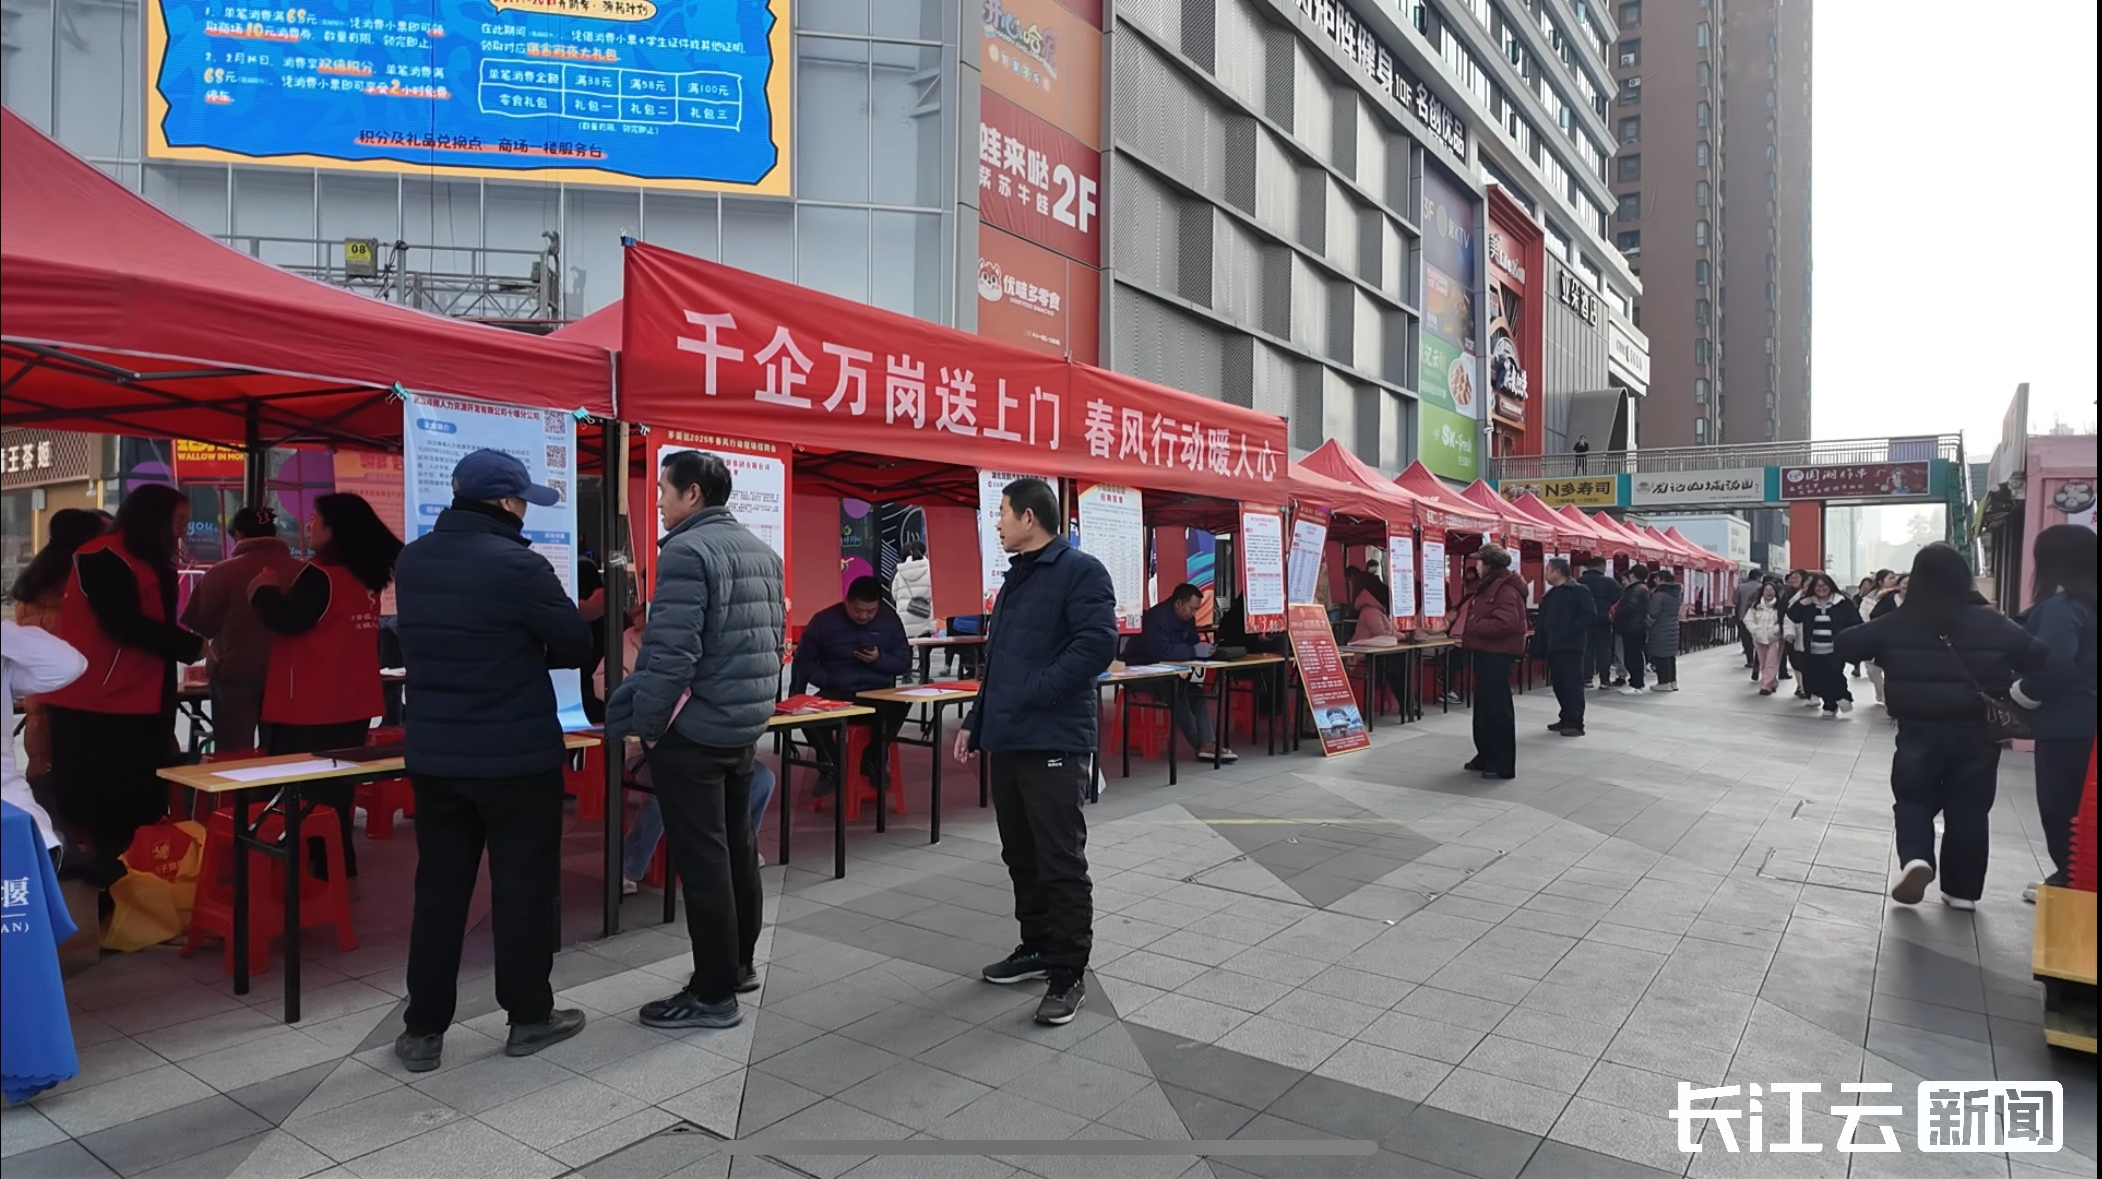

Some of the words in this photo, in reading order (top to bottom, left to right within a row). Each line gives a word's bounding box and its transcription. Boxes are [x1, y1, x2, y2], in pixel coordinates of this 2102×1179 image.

[575, 74, 612, 88] 满38元
[687, 83, 730, 97] 满100元
[498, 93, 548, 109] 零食礼包
[574, 99, 613, 112] 礼包一
[630, 103, 668, 116] 礼包二
[690, 107, 728, 120] 礼包三
[1416, 82, 1465, 158] 名创优品
[1052, 163, 1097, 233] 2F
[351, 243, 367, 254] 08
[676, 309, 1060, 450] 千企万岗送上门
[1084, 398, 1277, 482] 春风行动暖人心
[177, 452, 216, 461] WALLOW
[217, 452, 227, 461] IN
[1545, 480, 1611, 497] N多寿司
